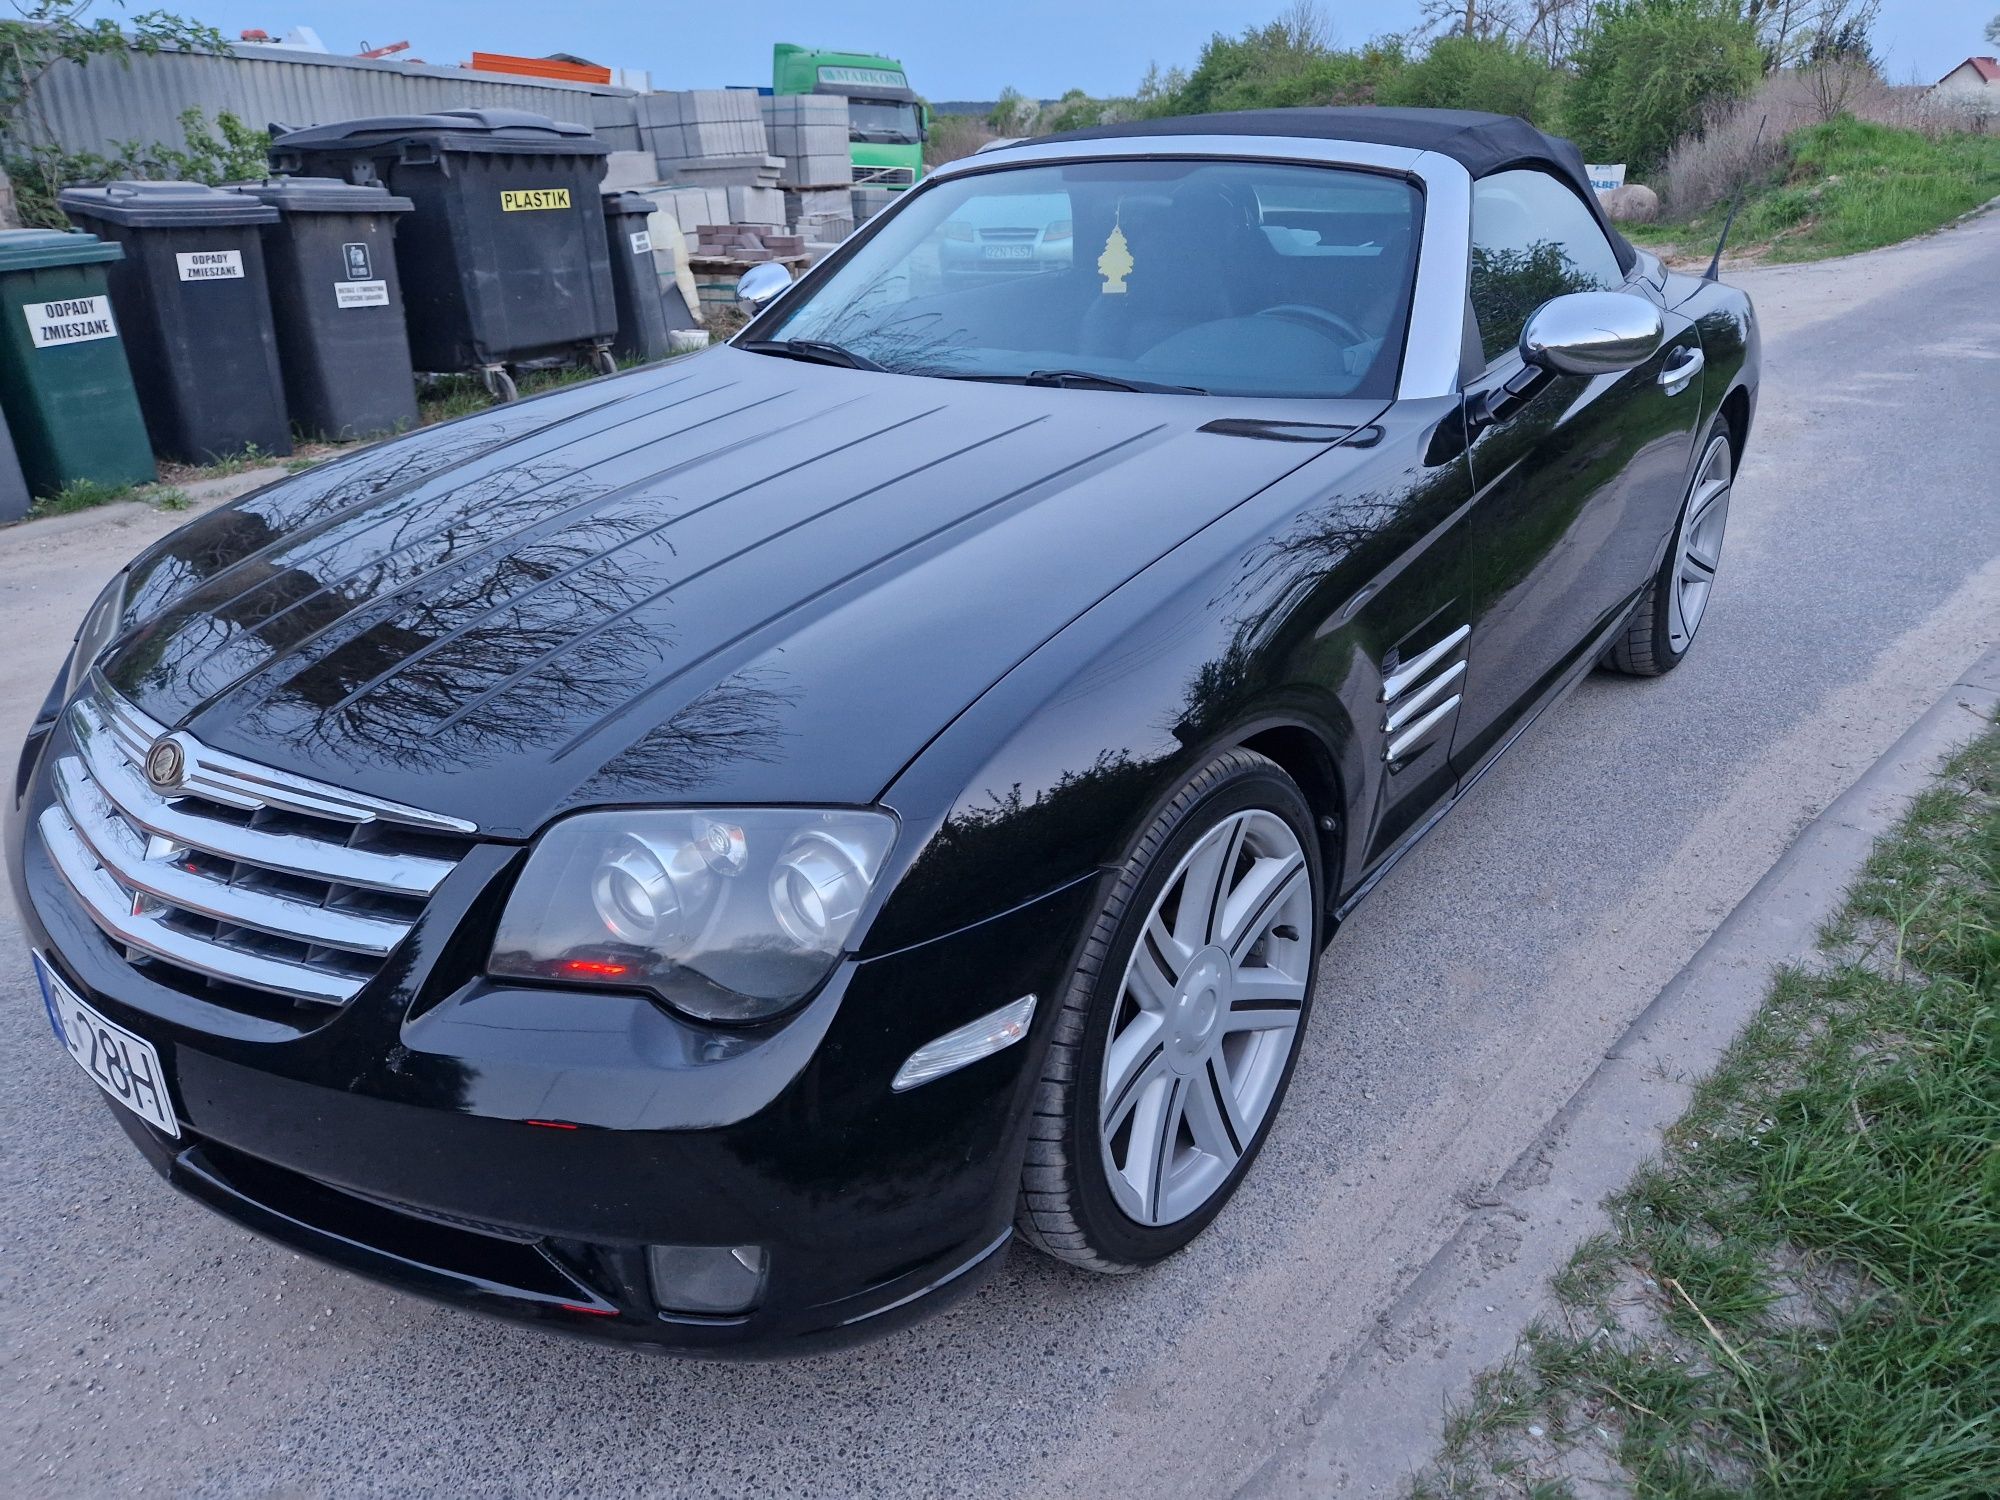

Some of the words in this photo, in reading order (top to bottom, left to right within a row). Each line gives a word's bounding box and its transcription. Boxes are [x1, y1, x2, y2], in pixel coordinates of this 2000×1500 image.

[504, 191, 568, 209] PLASTIK
[192, 254, 228, 265] ODPADY
[187, 266, 237, 277] ZMIESZANE
[45, 300, 95, 318] ODPADY
[41, 319, 110, 340] ZMIESZANE
